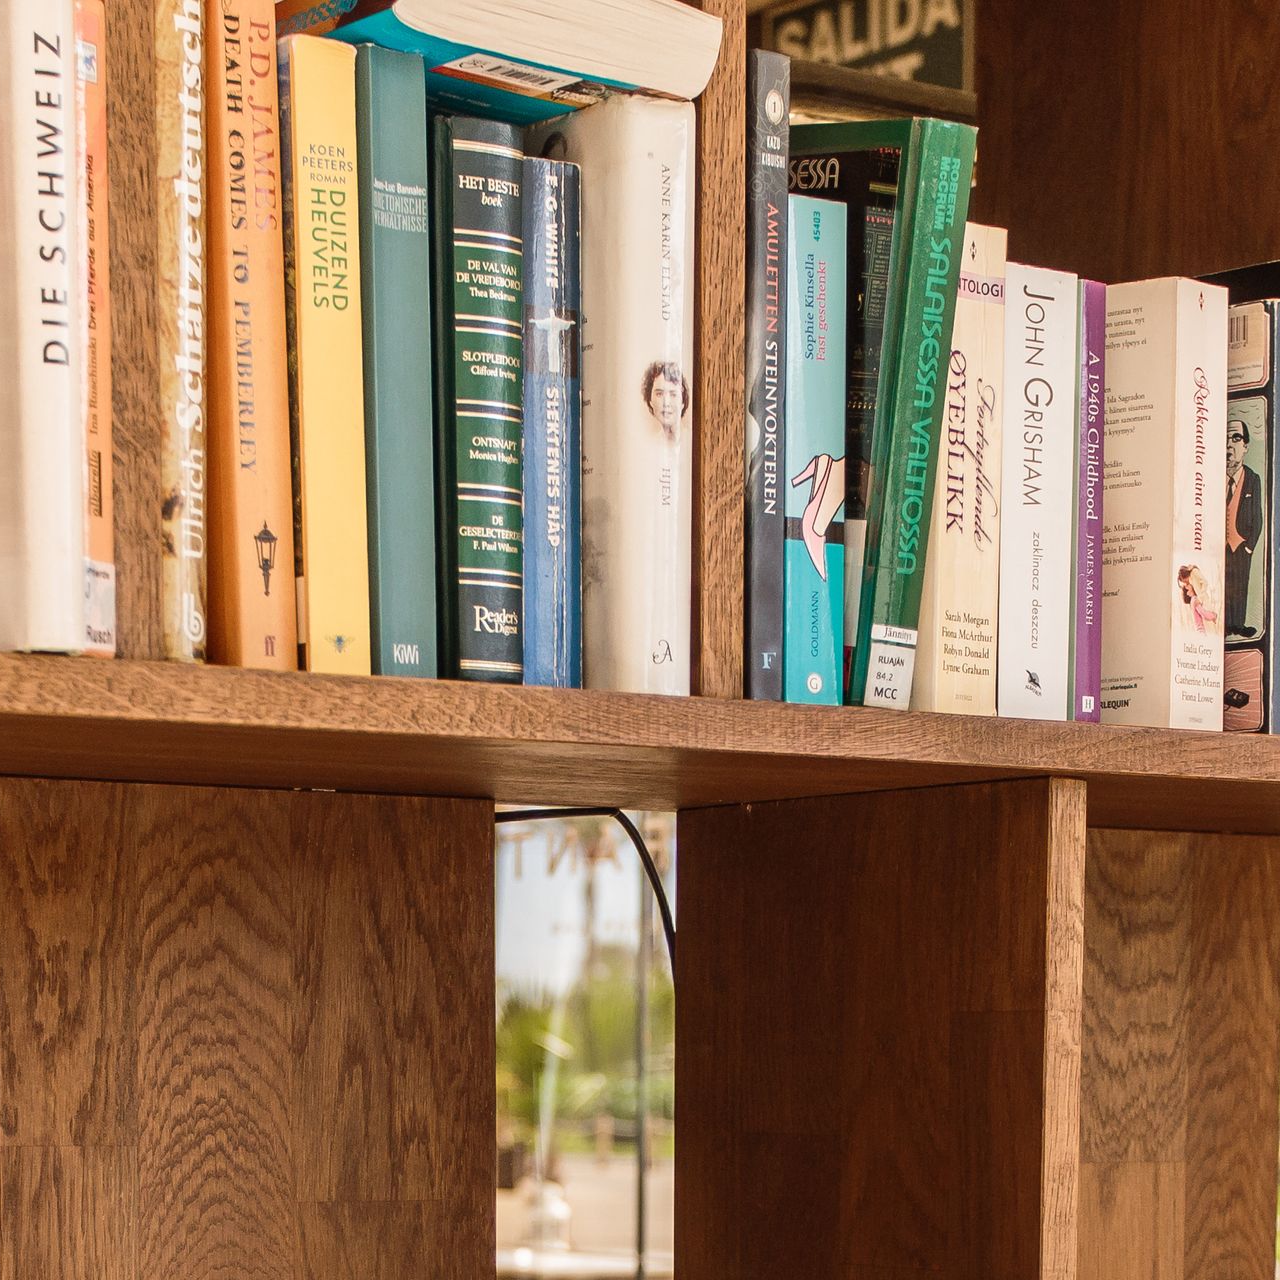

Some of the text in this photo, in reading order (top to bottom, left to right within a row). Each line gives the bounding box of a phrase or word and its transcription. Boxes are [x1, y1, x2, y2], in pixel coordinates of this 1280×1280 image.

[776, 0, 960, 61] SALIDA
[247, 17, 278, 231] P.D. JAMES
[310, 144, 345, 157] KOEN
[767, 135, 781, 150] KAZU
[303, 156, 354, 172] PEETERS
[310, 173, 346, 184] ROMAN
[34, 31, 69, 366] DIE SCHWEIZ
[397, 182, 427, 196] Bannalec
[458, 175, 520, 198] HET BESTE
[481, 192, 503, 208] boek
[933, 156, 952, 230] McCRUM
[948, 157, 961, 226] ROBERT
[85, 154, 97, 330] Drei Pferde aus Amerika
[813, 210, 821, 242] 45403
[223, 12, 257, 475] DEATH COMES TO PEMBERLEY
[311, 188, 330, 309] HEUVELS
[329, 191, 349, 311] DUIZEND
[544, 223, 559, 289] WHITE
[660, 164, 671, 321] ANNE KARIN ELSTAD
[456, 272, 469, 283] DE
[467, 259, 517, 277] DE VAL VAN
[469, 286, 488, 299] Thea
[804, 253, 816, 360] Sophie Kinsella
[815, 261, 828, 361] Fast geschenkt
[471, 365, 498, 377] Clifford
[764, 203, 780, 515] AMULETTEN STEINVOKTEREN
[175, 231, 204, 560] Ulrich Schätze
[897, 237, 951, 576] SALAISESSA VALTIOSSA
[1022, 284, 1055, 507] JOHN GRISHAM
[545, 386, 560, 498] SLEKTENES
[945, 350, 967, 535] ØYEBLIKK
[1084, 351, 1102, 521] A 1940s Childhood
[470, 449, 497, 463] Monica
[660, 468, 671, 506] HJEM
[1194, 471, 1204, 504] aina
[492, 515, 504, 526] DE
[1193, 511, 1203, 551] vaan
[482, 541, 497, 552] Paul
[1031, 532, 1042, 649] zaklinacz deszczu
[1084, 584, 1094, 626] MARSH
[473, 605, 518, 633] Reader's
[495, 623, 518, 636] Digest
[811, 590, 819, 657] GOLDMANN
[942, 626, 993, 643] Fiona McArthur
[945, 610, 990, 628] Sarah Morgan
[393, 643, 419, 665] KiWi
[761, 652, 777, 670] F
[943, 643, 990, 659] Robyn Donald
[1198, 645, 1213, 658] Grey
[876, 672, 894, 681] 84.2
[942, 660, 990, 676] Lynne Graham
[873, 687, 898, 700] MCC
